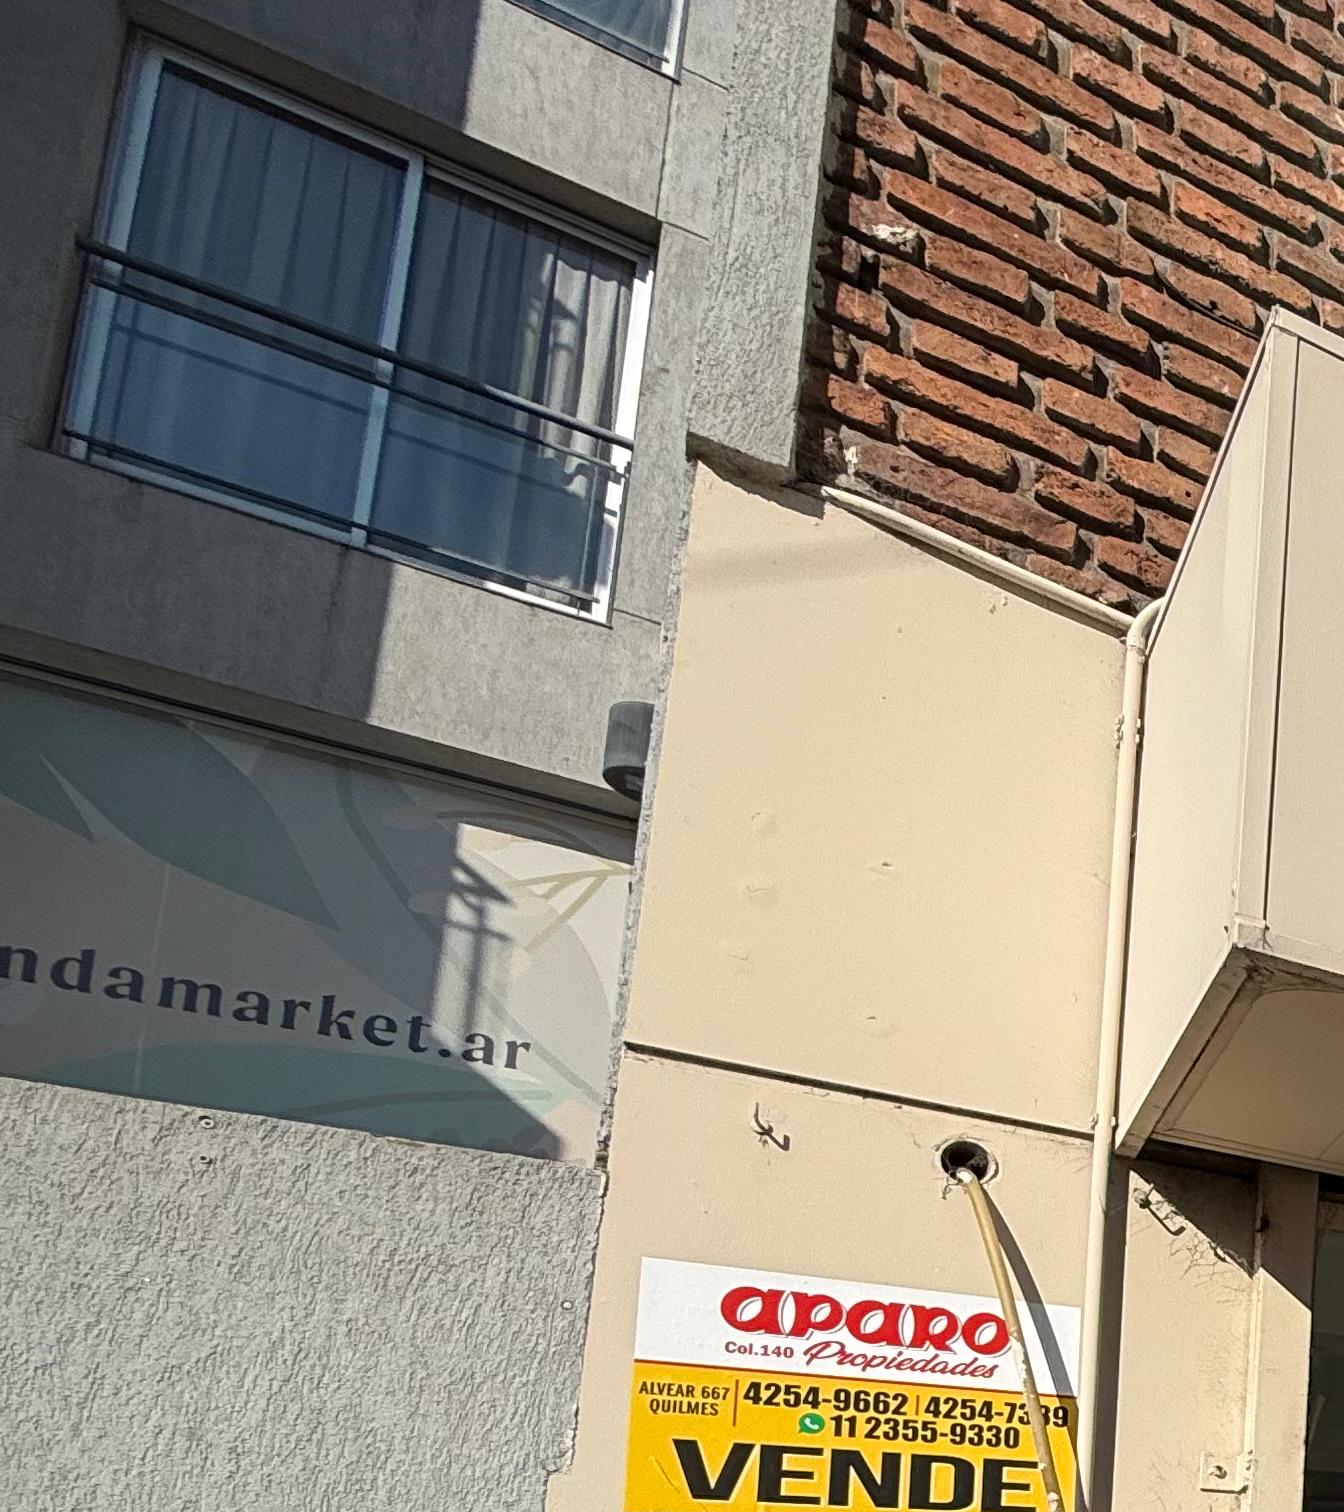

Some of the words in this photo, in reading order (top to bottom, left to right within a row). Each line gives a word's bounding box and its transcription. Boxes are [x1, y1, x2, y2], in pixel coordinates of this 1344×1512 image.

[724, 1340, 795, 1359] Col.140
[802, 1340, 1000, 1379] Propiedades
[638, 1380, 695, 1398] ALVEAR
[700, 1385, 731, 1401] 667
[649, 1398, 720, 1417] QUILMES
[742, 1380, 909, 1417] 4254-9662
[829, 1413, 858, 1438] 11
[863, 1415, 1021, 1449] 2355-9330
